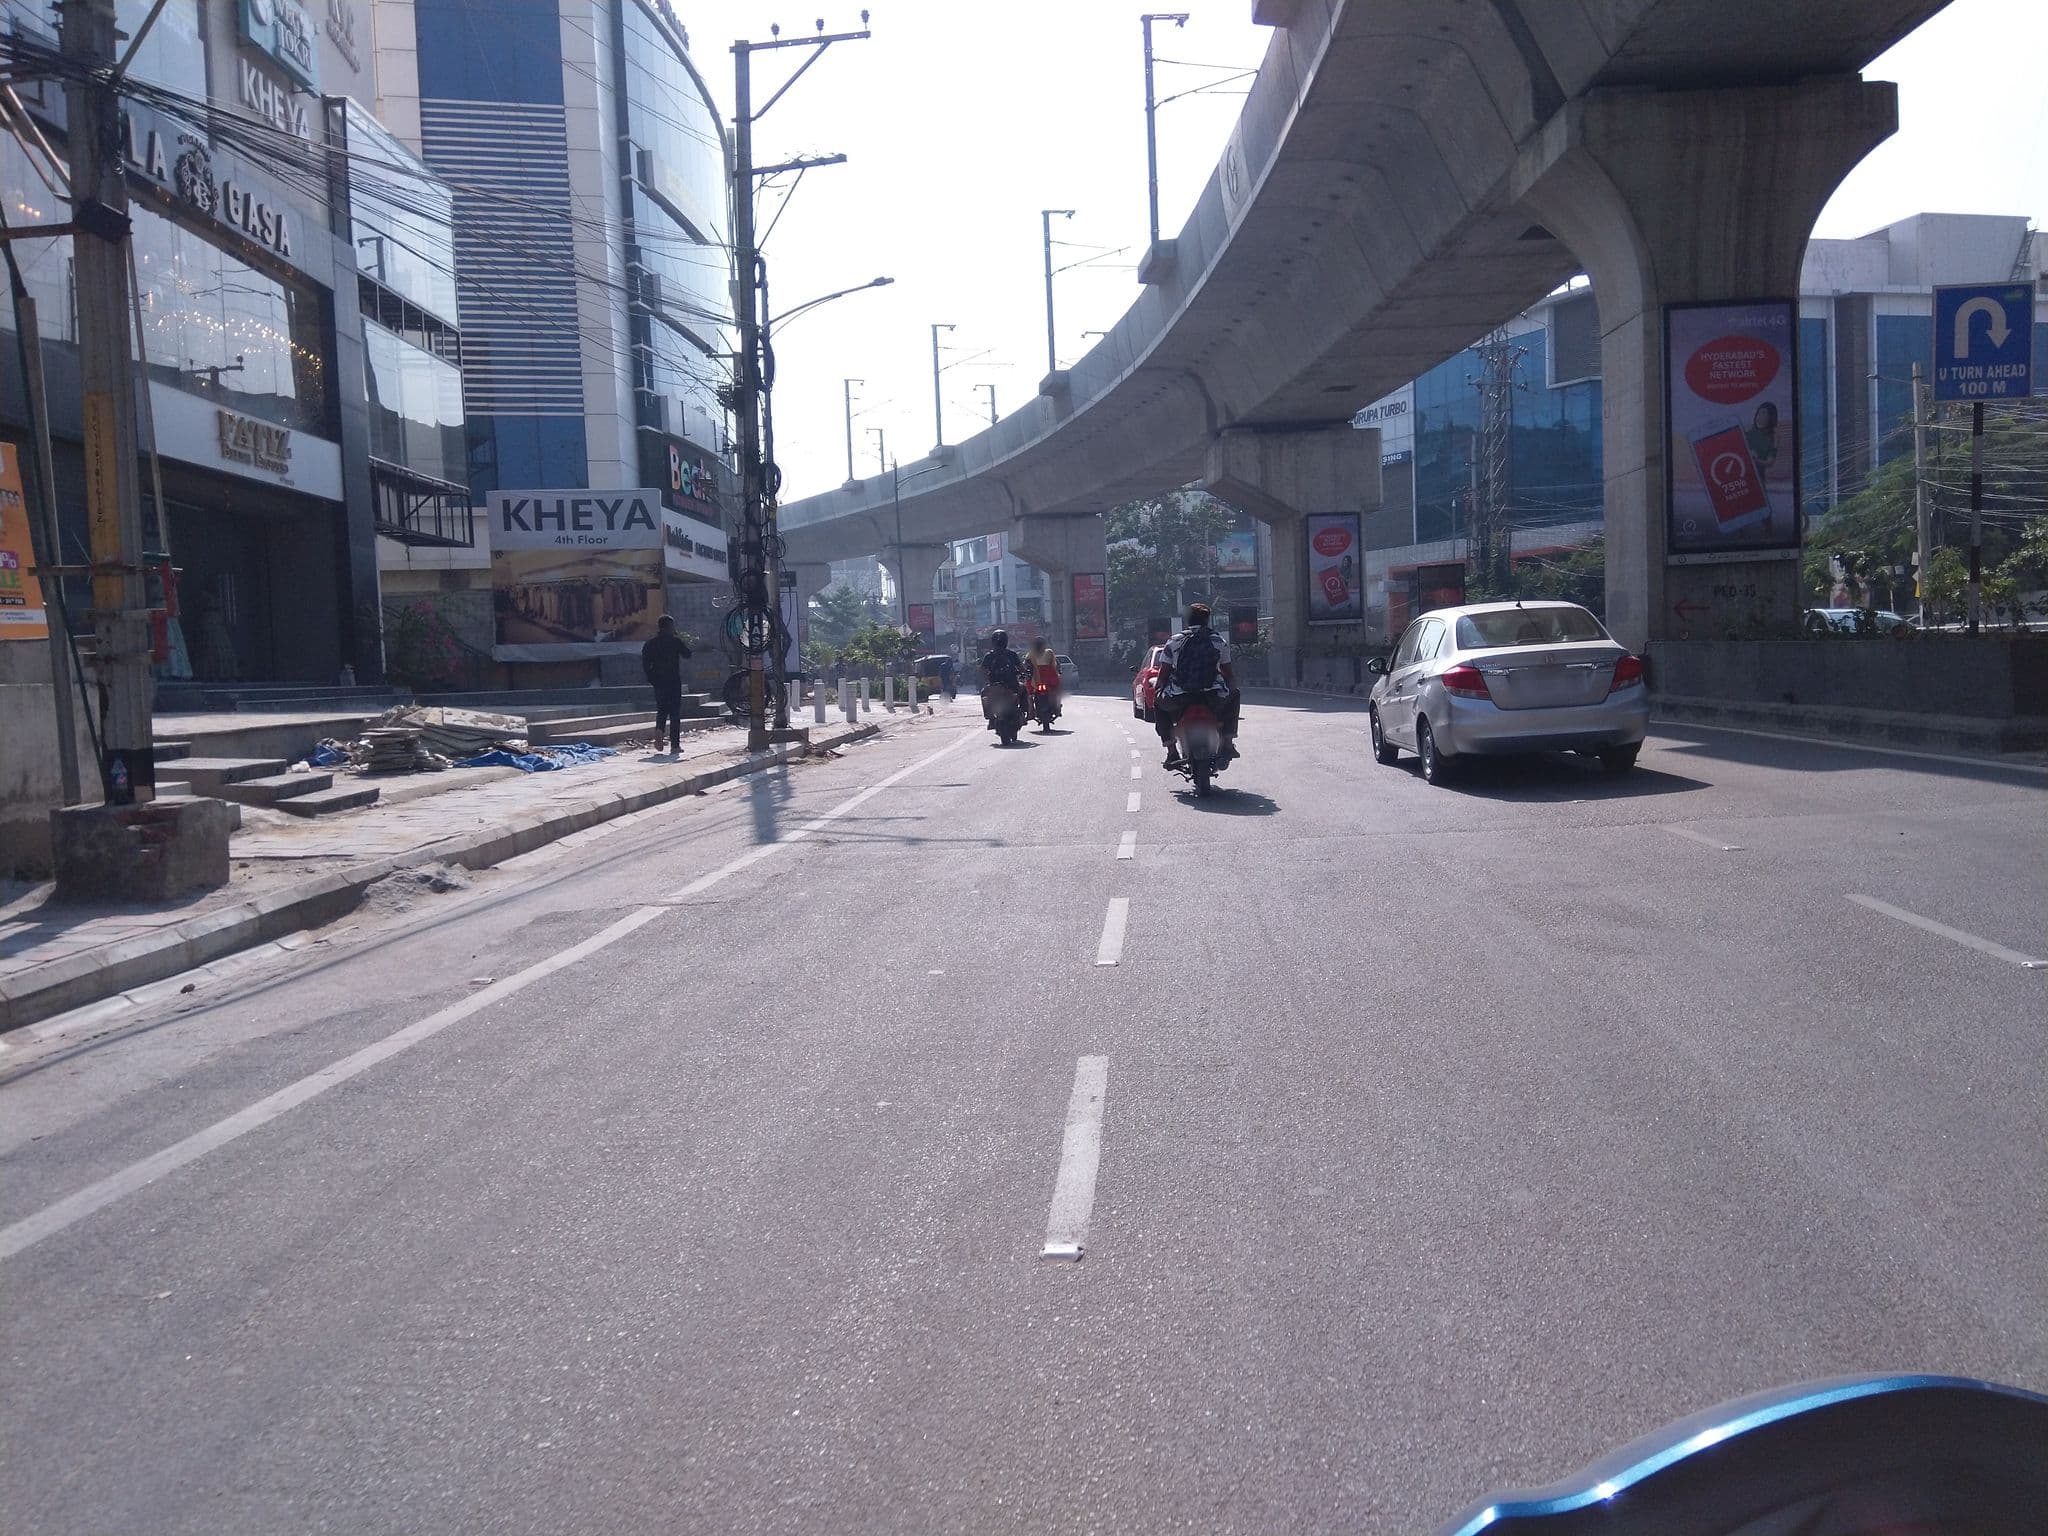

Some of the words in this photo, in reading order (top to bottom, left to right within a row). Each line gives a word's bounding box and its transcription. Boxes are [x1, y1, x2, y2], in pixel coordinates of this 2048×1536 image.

[241, 58, 312, 151] KHEYA
[127, 114, 168, 181] LA
[1939, 367, 1947, 380] U
[1951, 366, 1982, 380] TURN
[1986, 364, 2026, 378] AHEAD
[1959, 382, 1987, 395] 100
[1993, 380, 2006, 393] M
[1380, 401, 1407, 419] TURBO
[1721, 479, 1747, 493] 75%
[502, 499, 656, 531] KHEYA
[554, 535, 573, 545] 4th
[578, 535, 608, 545] Floor
